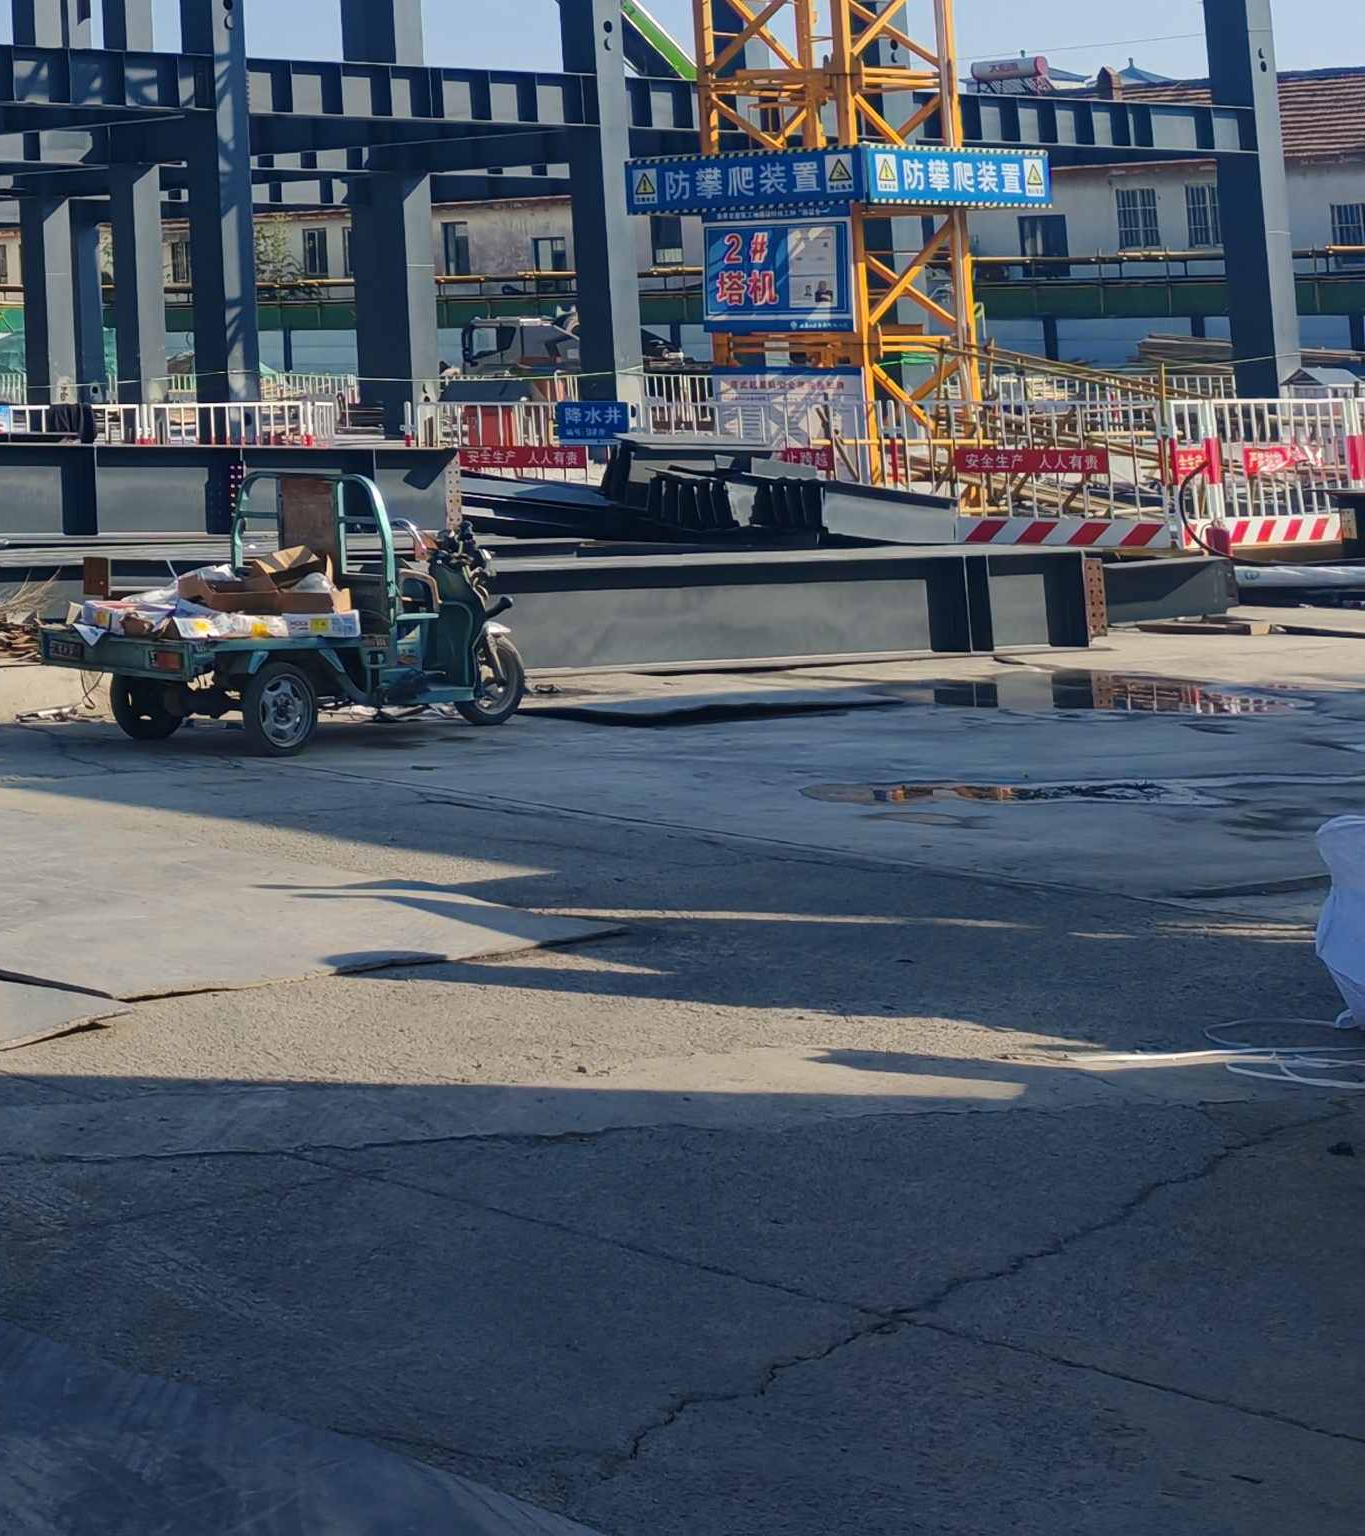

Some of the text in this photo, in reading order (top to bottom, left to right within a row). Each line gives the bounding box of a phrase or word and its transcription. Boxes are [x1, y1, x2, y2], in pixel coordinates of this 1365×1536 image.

[664, 161, 822, 202] 防攀爬装置
[902, 158, 1023, 195] 防攀爬装置
[715, 271, 780, 307] 塔机
[564, 405, 623, 425] 降水井
[466, 449, 579, 465] 安全生产 人人有责
[964, 453, 1099, 470] 安全生产 人人有责
